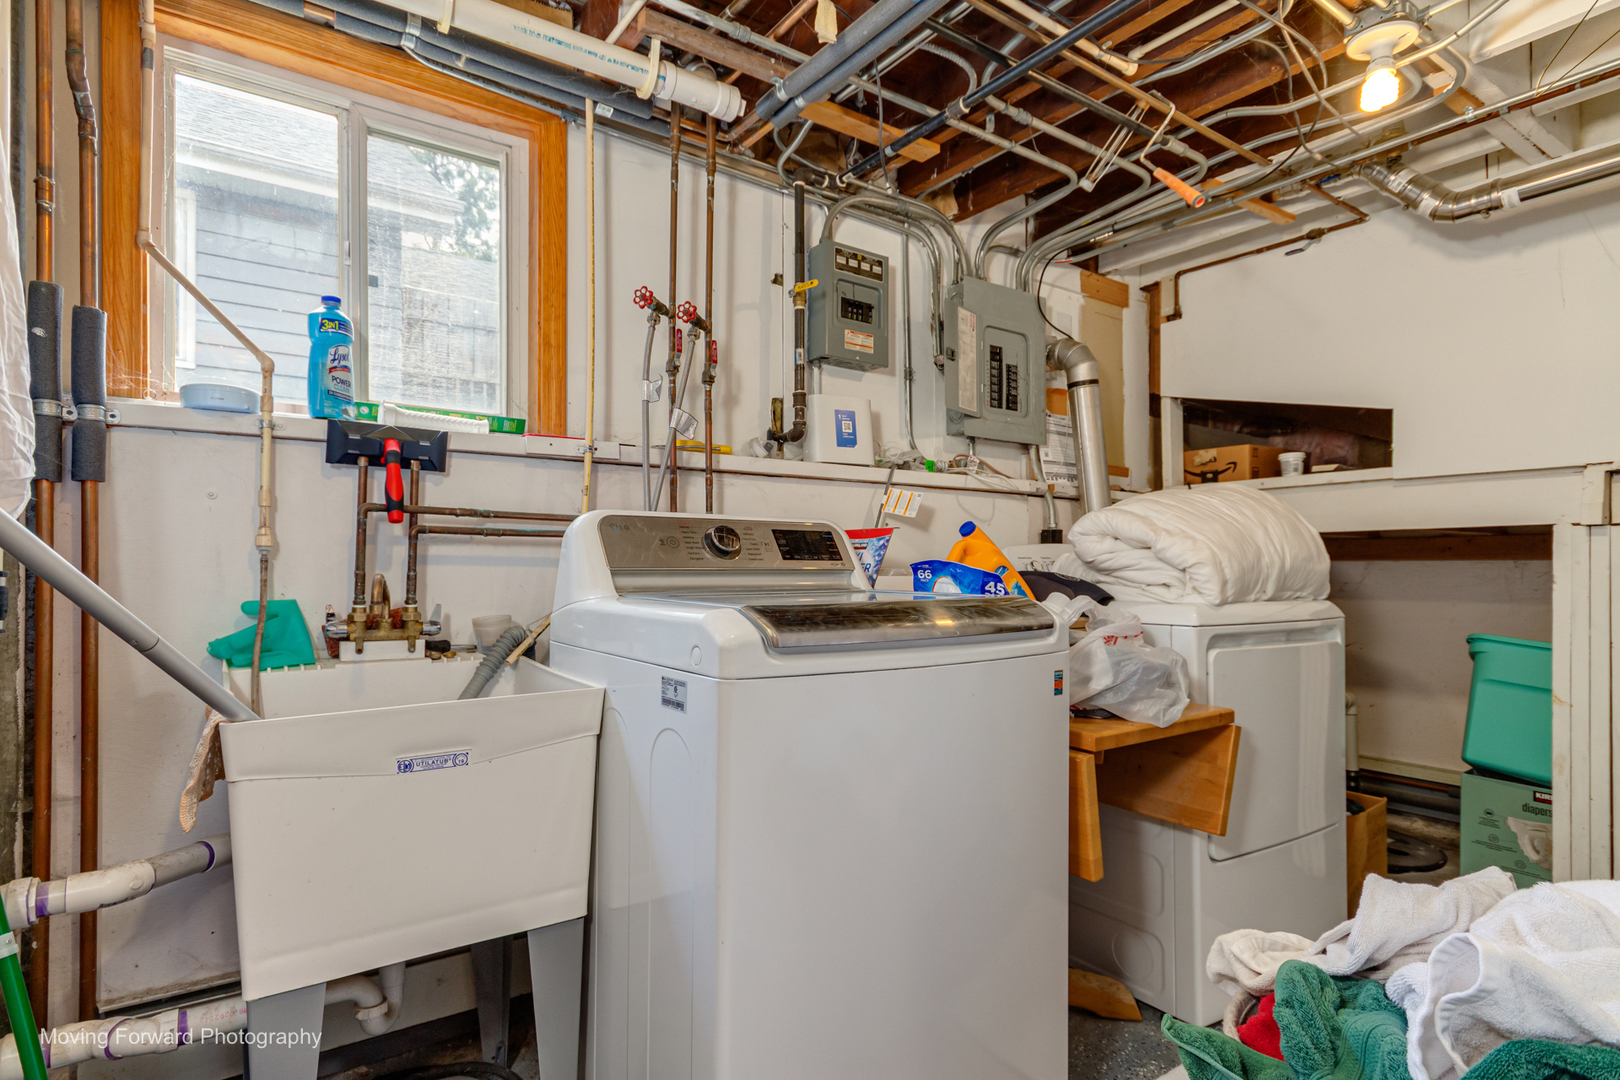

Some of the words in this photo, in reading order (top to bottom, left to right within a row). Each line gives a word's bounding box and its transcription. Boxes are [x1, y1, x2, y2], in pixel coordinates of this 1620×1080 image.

[330, 347, 350, 366] Lysol
[331, 375, 351, 388] POWER
[334, 383, 350, 393] CLEAN
[917, 569, 932, 579] 66
[985, 581, 1006, 596] 45
[415, 758, 449, 767] UTILATUB
[1535, 792, 1553, 801] KIR
[1522, 803, 1553, 818] diapers
